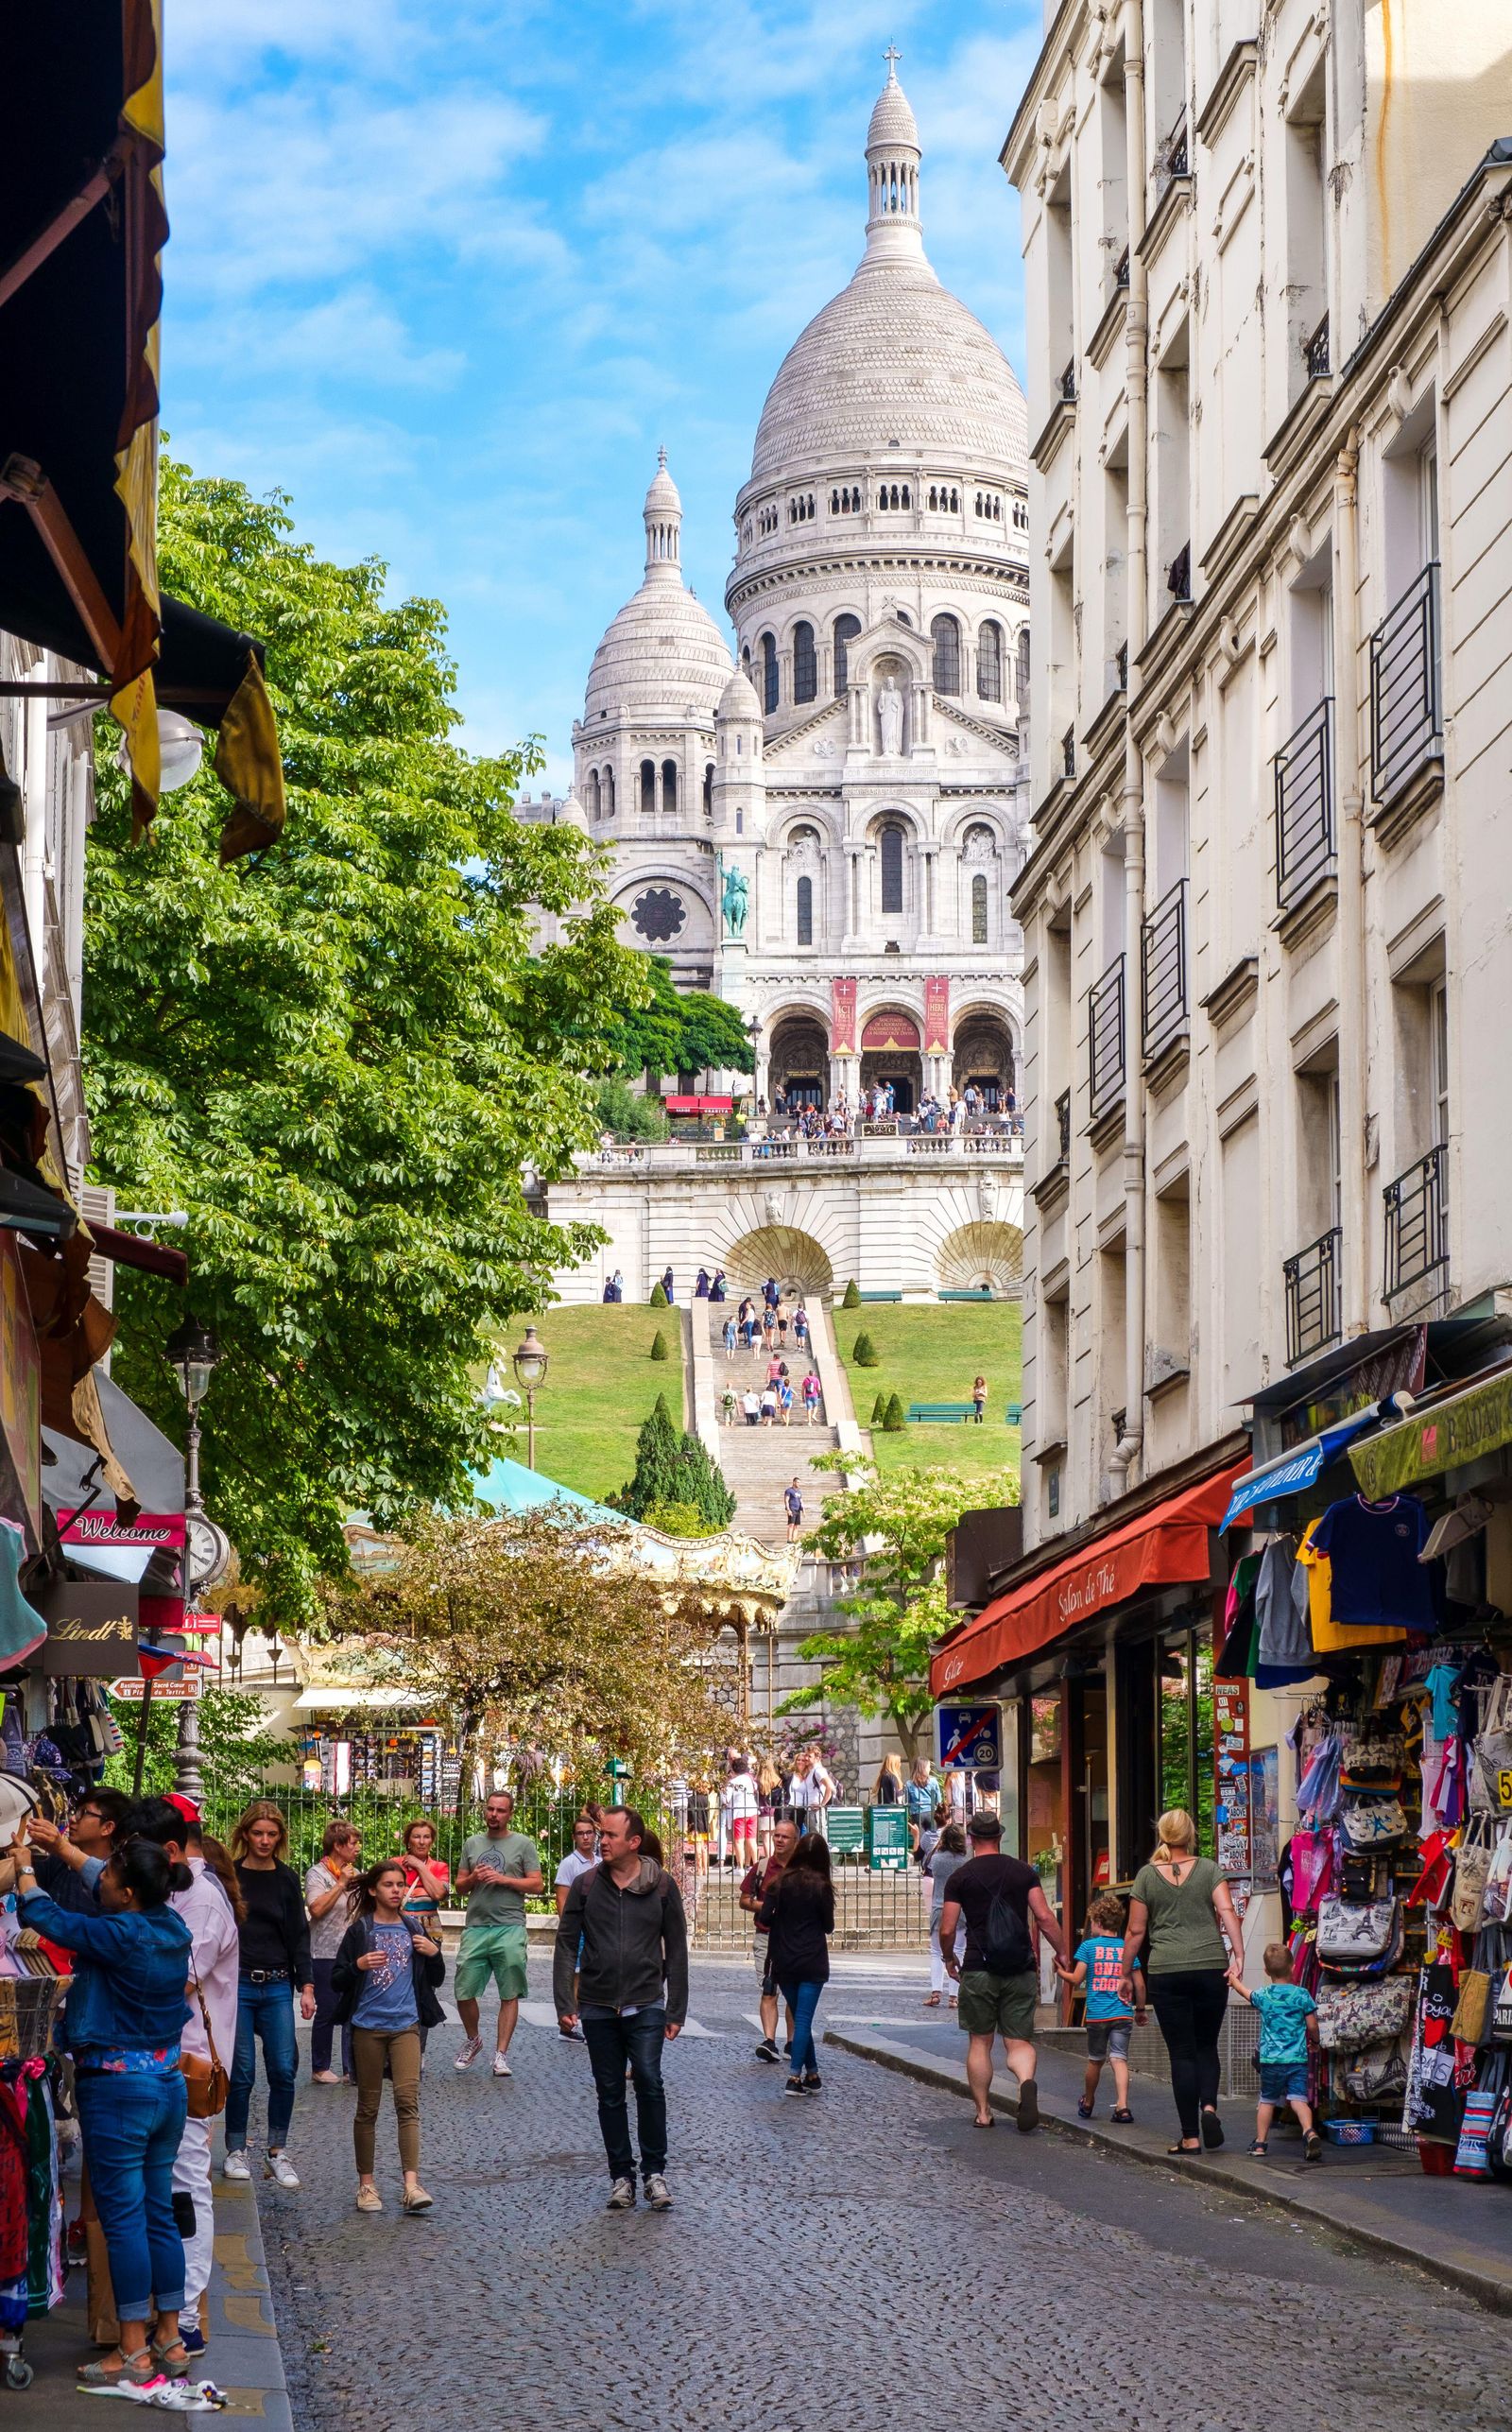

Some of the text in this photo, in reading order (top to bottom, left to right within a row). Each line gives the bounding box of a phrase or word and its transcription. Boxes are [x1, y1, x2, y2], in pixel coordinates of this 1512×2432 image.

[838, 1006, 850, 1014] ICI
[73, 1516, 171, 1542] Welcome
[1057, 1564, 1115, 1622] Salon de Thé
[49, 1617, 118, 1641] Lindt
[979, 1750, 992, 1758] 20
[1501, 1772, 1512, 1801] 5
[1230, 1807, 1246, 1817] ABOVE
[1229, 1850, 1246, 1859] ABOVE
[1091, 1977, 1119, 1992] COO
